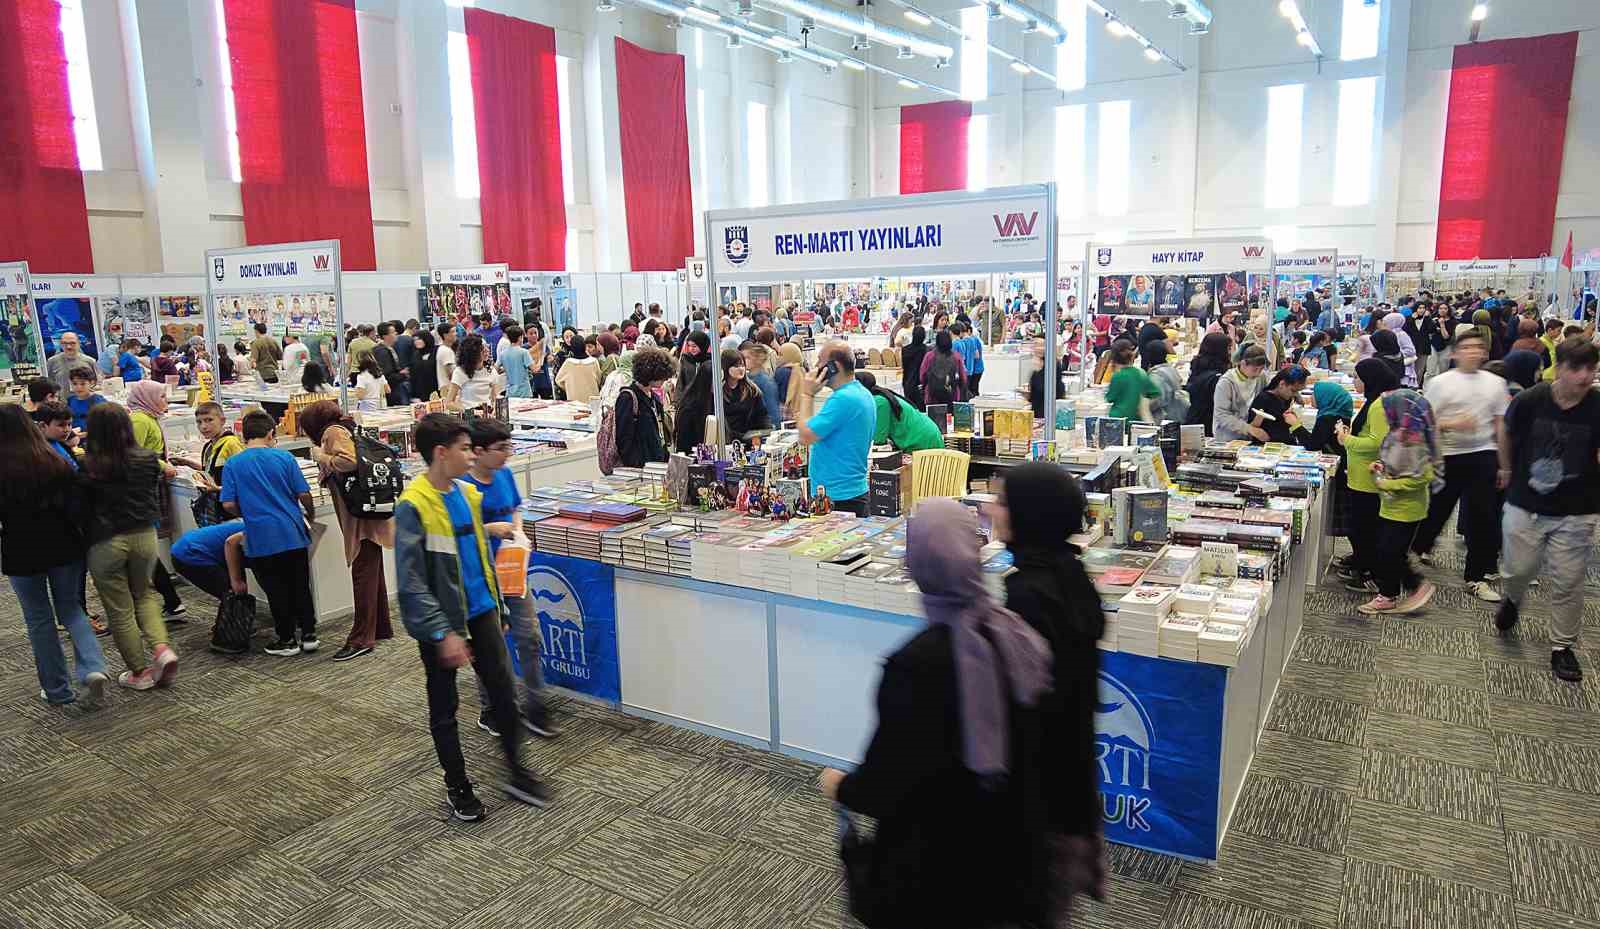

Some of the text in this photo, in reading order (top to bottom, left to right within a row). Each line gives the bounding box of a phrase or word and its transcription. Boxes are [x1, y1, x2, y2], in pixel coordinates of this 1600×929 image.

[775, 224, 942, 255] REN-MARTI YAYINLARI
[239, 261, 298, 278] DOKUZ YAYINLARI
[1152, 250, 1204, 263] HAYY KİTAP
[550, 659, 591, 680] GRUBU
[1094, 742, 1152, 791] RTI
[1101, 793, 1151, 832] UK
